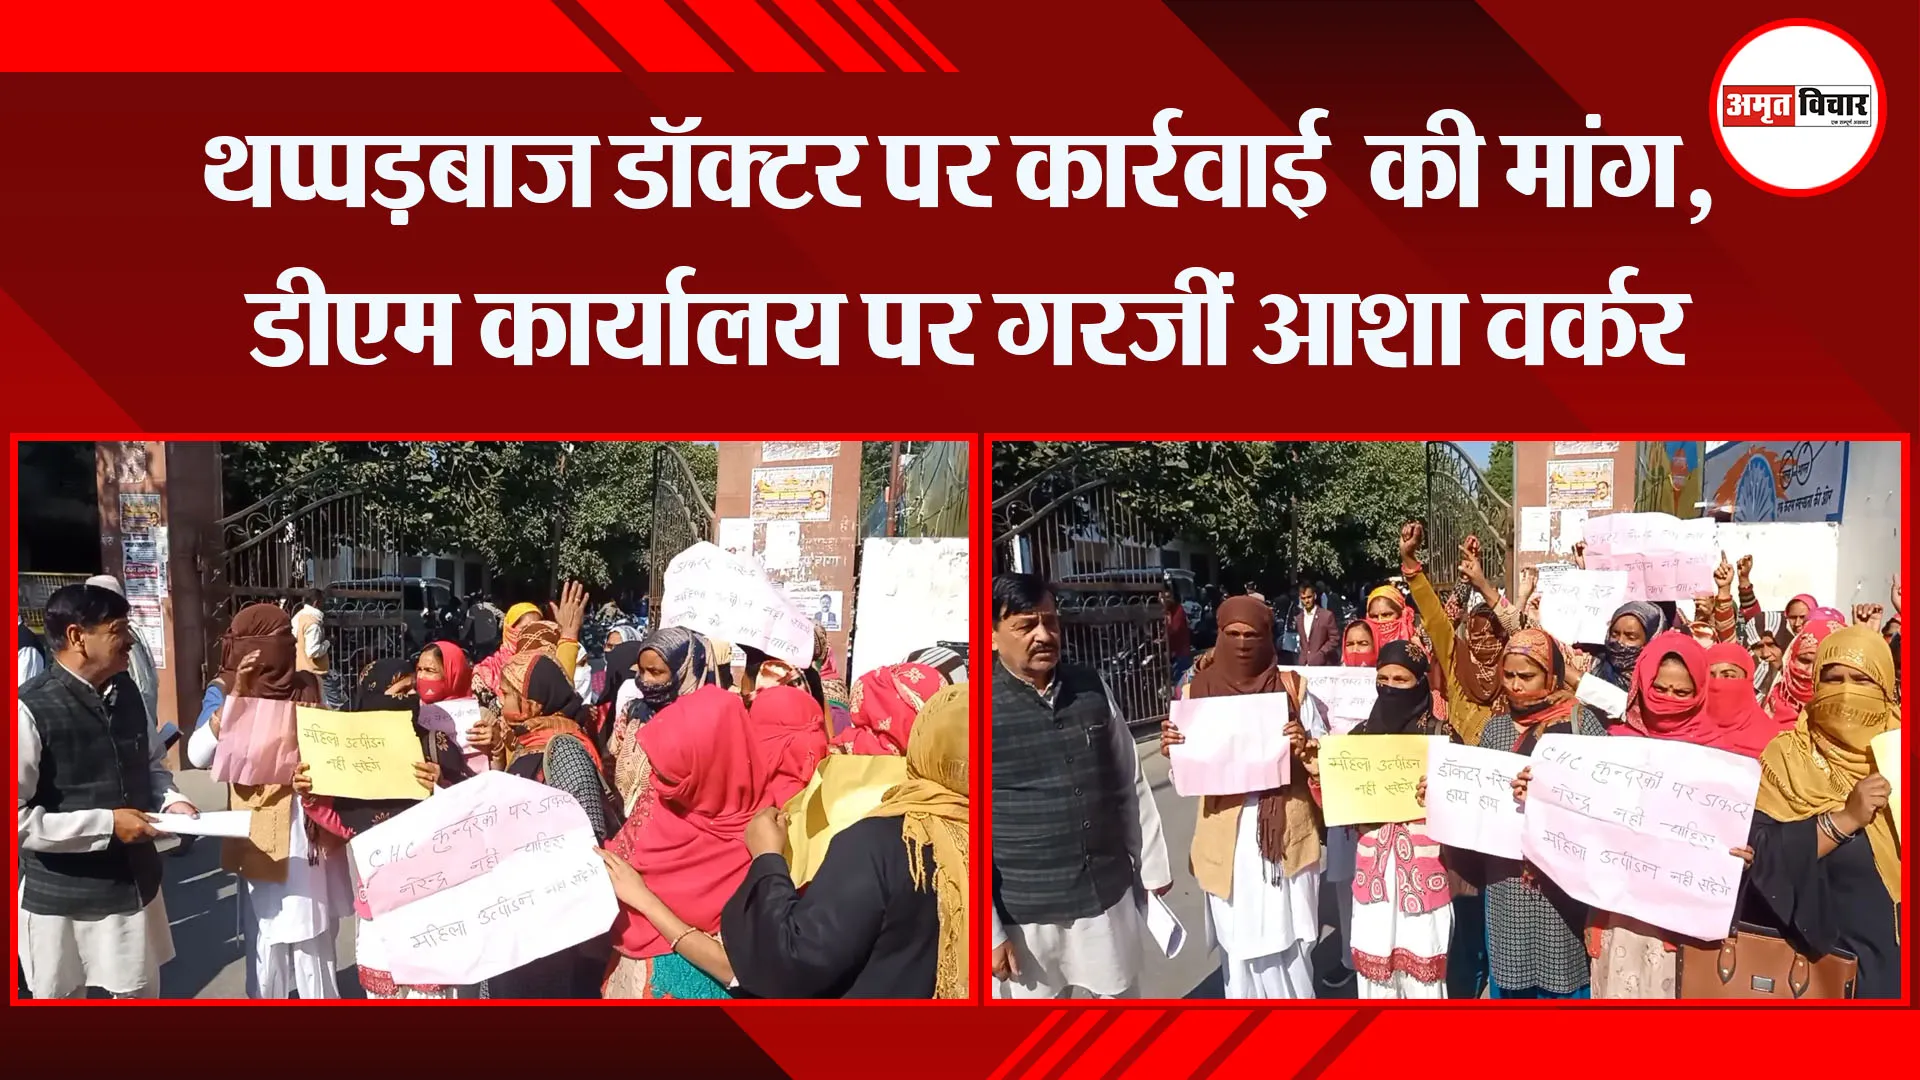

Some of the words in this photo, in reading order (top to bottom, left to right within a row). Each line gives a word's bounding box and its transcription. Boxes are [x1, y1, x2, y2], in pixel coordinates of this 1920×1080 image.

[1327, 750, 1371, 772] महिला
[1446, 788, 1470, 805] हाय
[1671, 781, 1700, 803] पर
[1542, 829, 1588, 862] महिला
[410, 920, 468, 948] महिला
